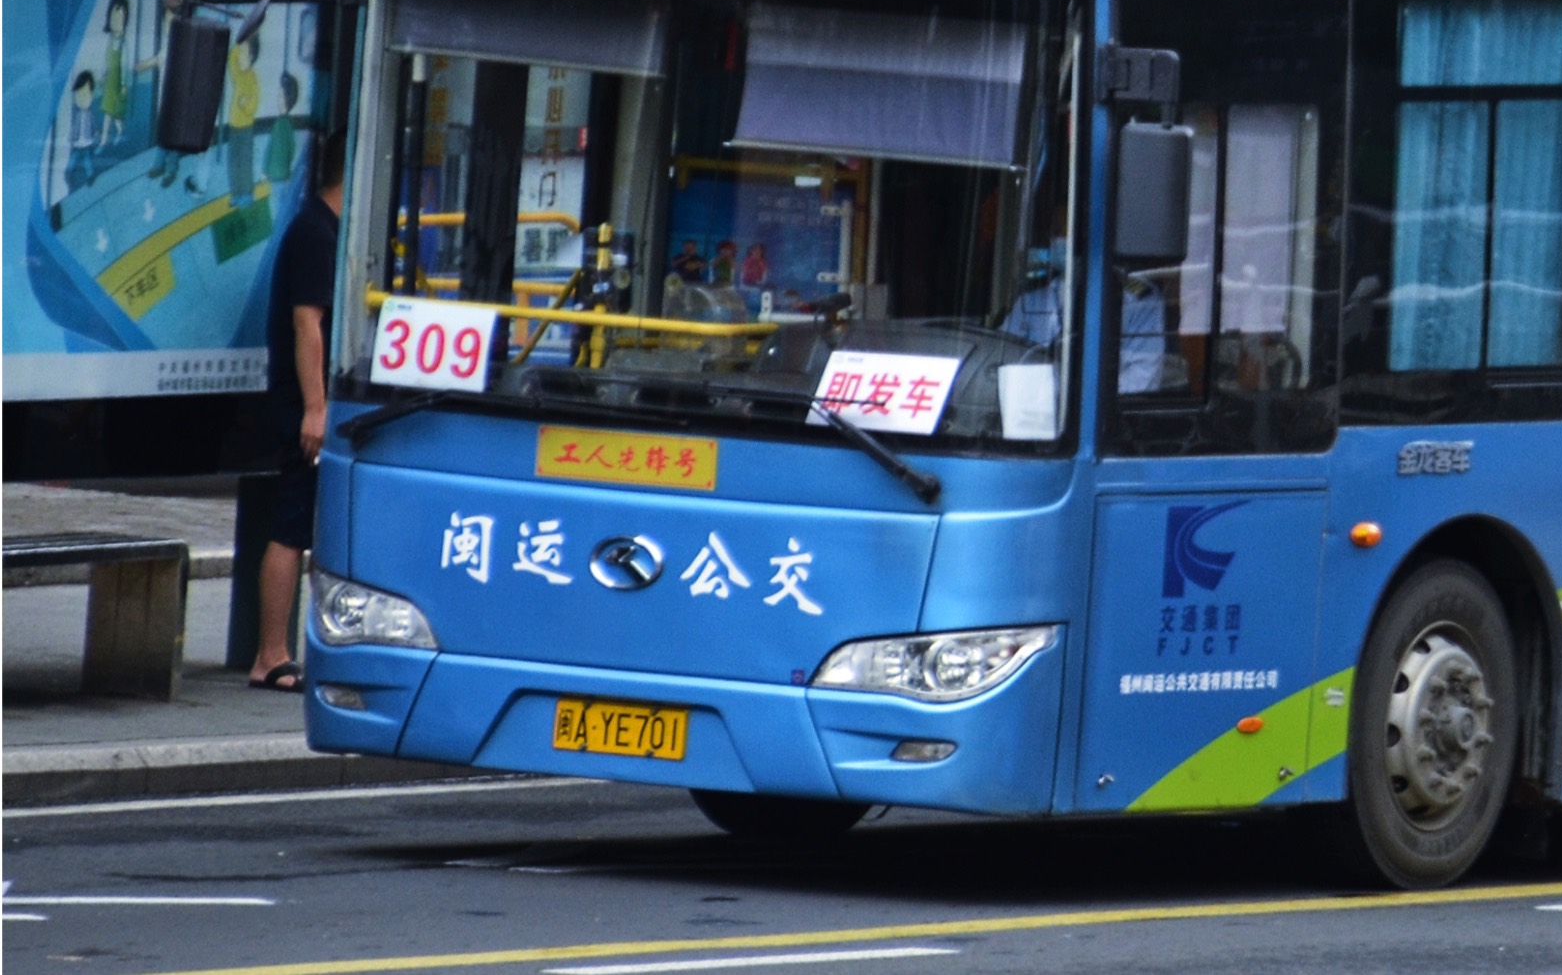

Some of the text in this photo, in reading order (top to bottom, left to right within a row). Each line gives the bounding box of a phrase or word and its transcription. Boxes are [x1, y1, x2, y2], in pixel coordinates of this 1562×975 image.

[379, 317, 483, 379] 309
[820, 370, 941, 418] 即发车
[554, 441, 698, 478] 工人先锋号
[440, 511, 823, 617] 闽运 公交
[1160, 603, 1242, 634] 交通集团
